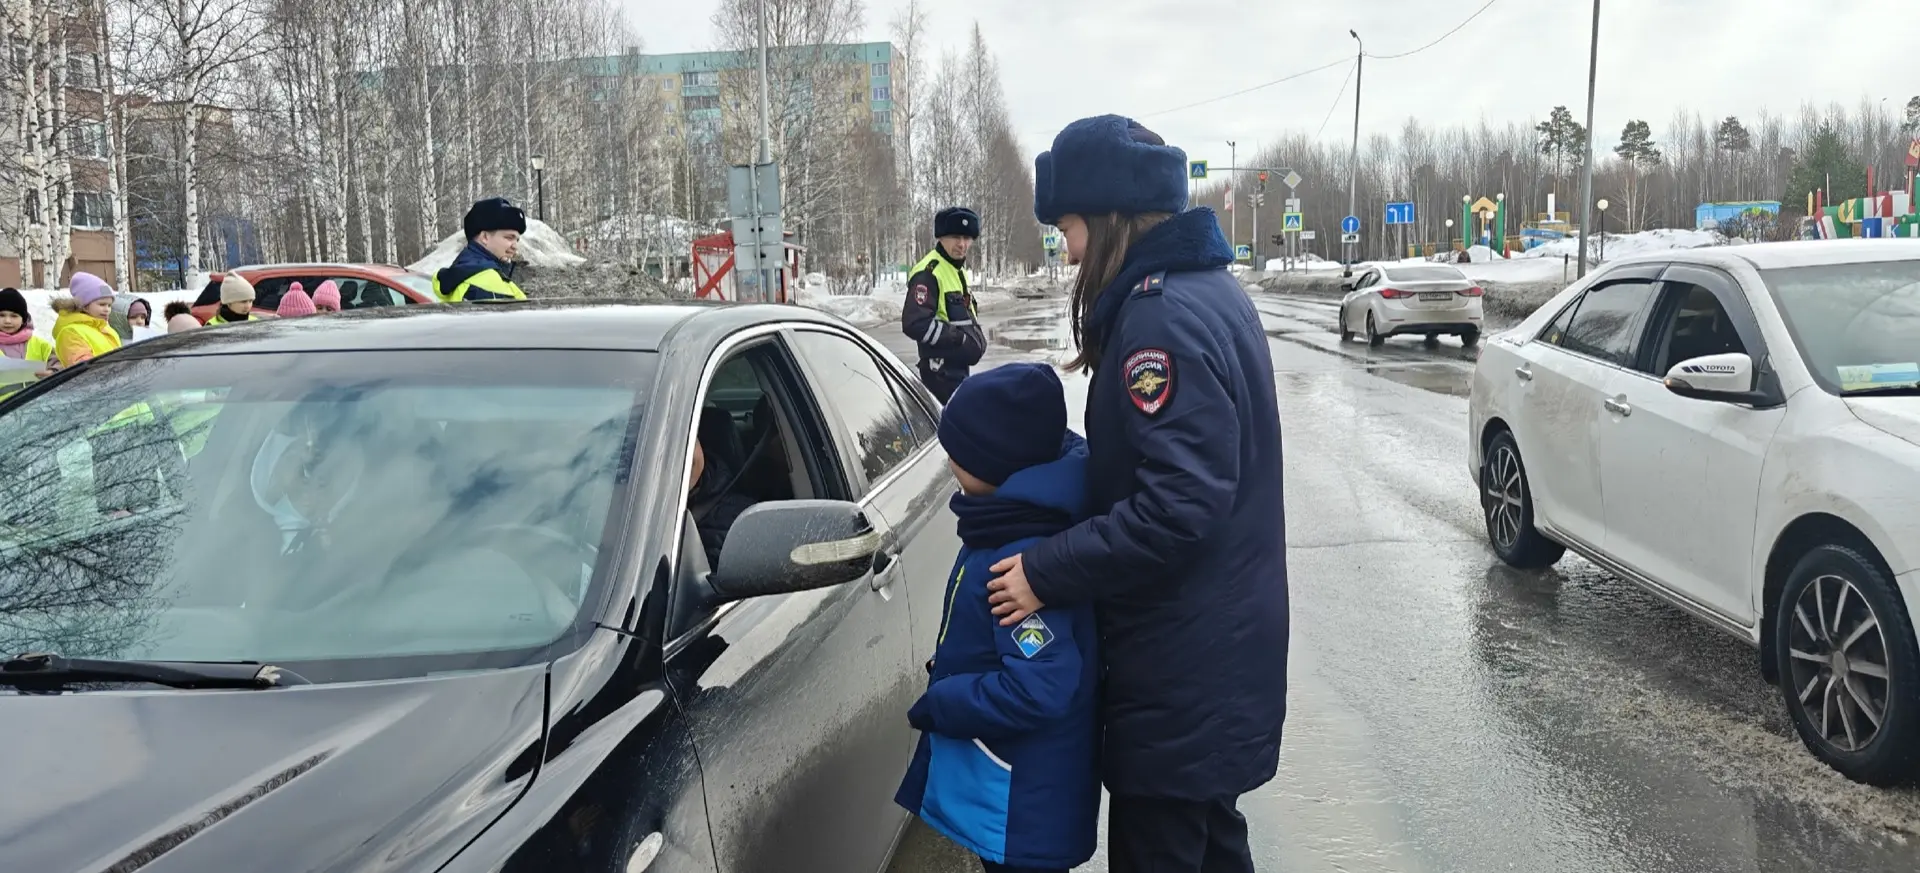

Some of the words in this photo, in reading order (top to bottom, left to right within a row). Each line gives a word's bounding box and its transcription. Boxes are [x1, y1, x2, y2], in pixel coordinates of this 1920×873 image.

[1126, 352, 1165, 369] ПОЛИЦИЯ
[1131, 361, 1162, 377] РОССИЯ
[1143, 400, 1160, 413] МВД
